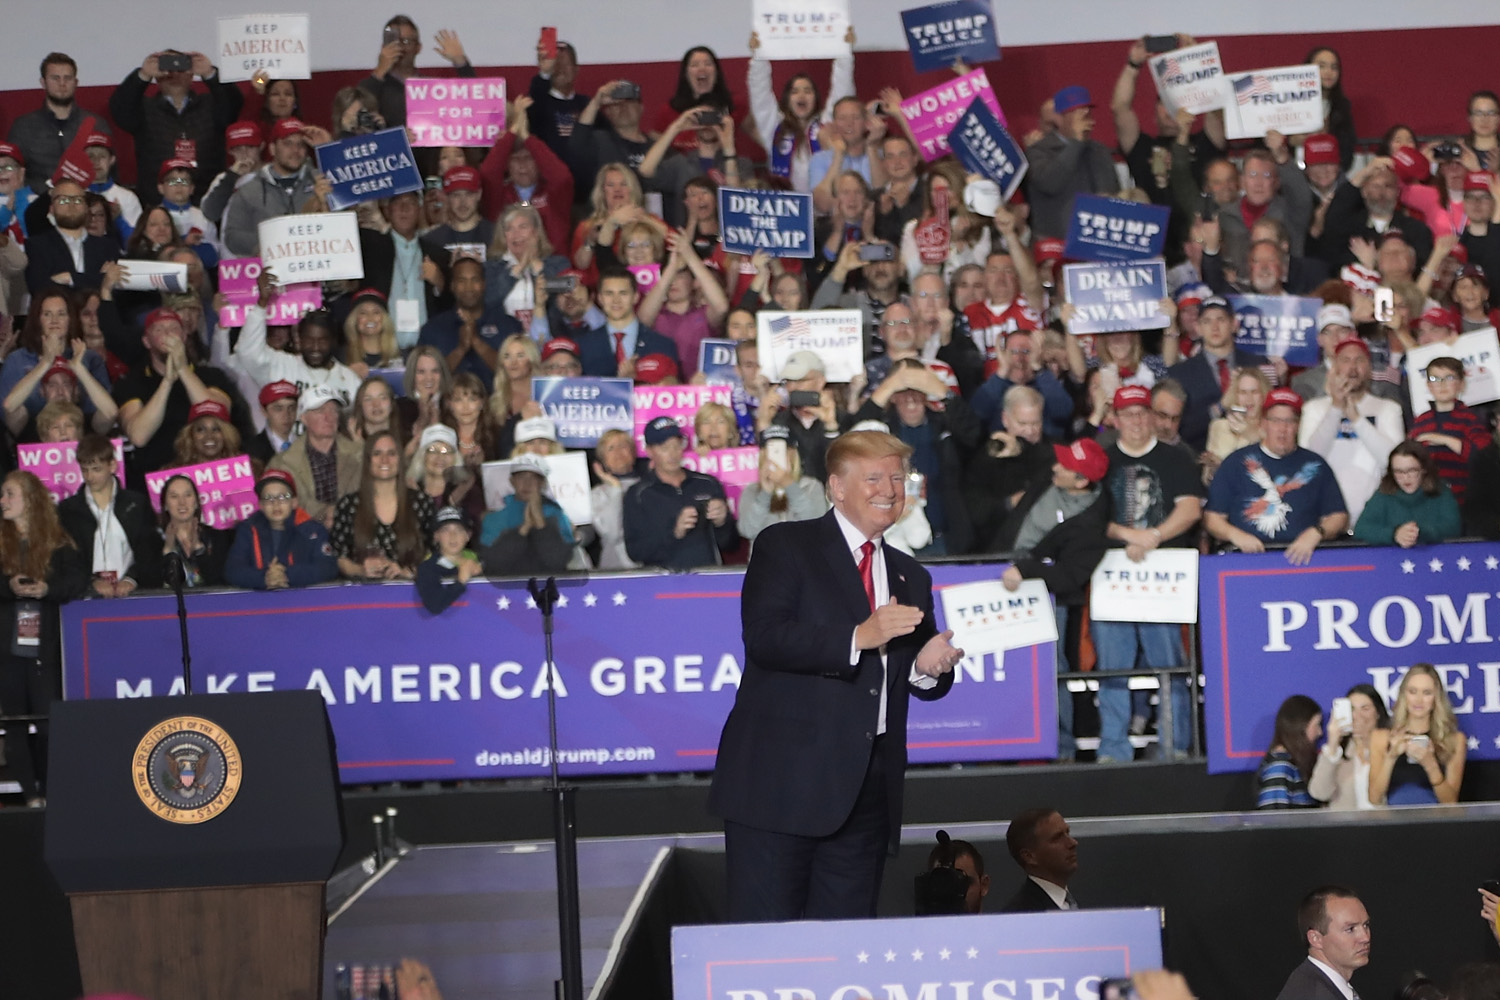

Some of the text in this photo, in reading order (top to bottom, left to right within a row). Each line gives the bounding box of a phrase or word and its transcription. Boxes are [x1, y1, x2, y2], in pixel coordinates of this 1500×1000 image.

[763, 13, 840, 24] TRUMP
[910, 14, 987, 40] TRUMP
[245, 24, 279, 35] KEEP
[770, 25, 834, 33] PENCE
[919, 29, 983, 48] PENCE
[222, 39, 305, 57] AMERICA
[242, 59, 282, 70] GREAT
[1166, 66, 1219, 87] TRUMP
[407, 83, 503, 100] WOMEN
[902, 73, 990, 120] WOMEN
[1251, 90, 1319, 105] TRUMP
[438, 107, 473, 118] FOR
[414, 125, 500, 142] TRUMP
[343, 142, 379, 160] KEEP
[967, 112, 1015, 177] TRUMP
[326, 152, 412, 184] AMERICA
[351, 176, 394, 195] GREAT
[730, 195, 800, 217] DRAIN
[288, 224, 324, 236] KEEP
[750, 217, 778, 230] THE
[1077, 210, 1160, 237] TRUMP
[726, 230, 807, 248] SWAMP
[1081, 226, 1152, 247] PENCE
[265, 239, 356, 262] AMERICA
[288, 259, 332, 273] GREAT
[1077, 267, 1154, 291] DRAIN
[1103, 288, 1133, 302] THE
[227, 303, 316, 322] TUMP
[1072, 300, 1161, 323] SWAMP
[1235, 313, 1315, 331] TRUMP
[787, 336, 859, 349] TRUMP
[1419, 351, 1491, 379] TMP
[563, 385, 600, 398] KEEP
[635, 390, 732, 410] WOMEN
[543, 403, 630, 422] AMERICA
[20, 444, 123, 466] WOMN
[682, 451, 759, 473] OMEN
[53, 471, 78, 485] FO
[149, 461, 250, 495] WMEN
[200, 491, 223, 505] OR
[200, 503, 254, 526] UMP
[1104, 570, 1187, 583] TRUMP
[957, 596, 1039, 619] TRUMP
[305, 660, 569, 706] AMERICA
[590, 654, 742, 698] GREA
[199, 723, 214, 735] THE
[136, 721, 183, 768] PRESIDENT
[215, 732, 239, 777] UNITED
[476, 746, 656, 768] donaldjrump.com
[137, 771, 147, 787] THE
[141, 787, 151, 798] OF
[197, 785, 234, 819] STATES
[151, 796, 179, 819] SEAL
